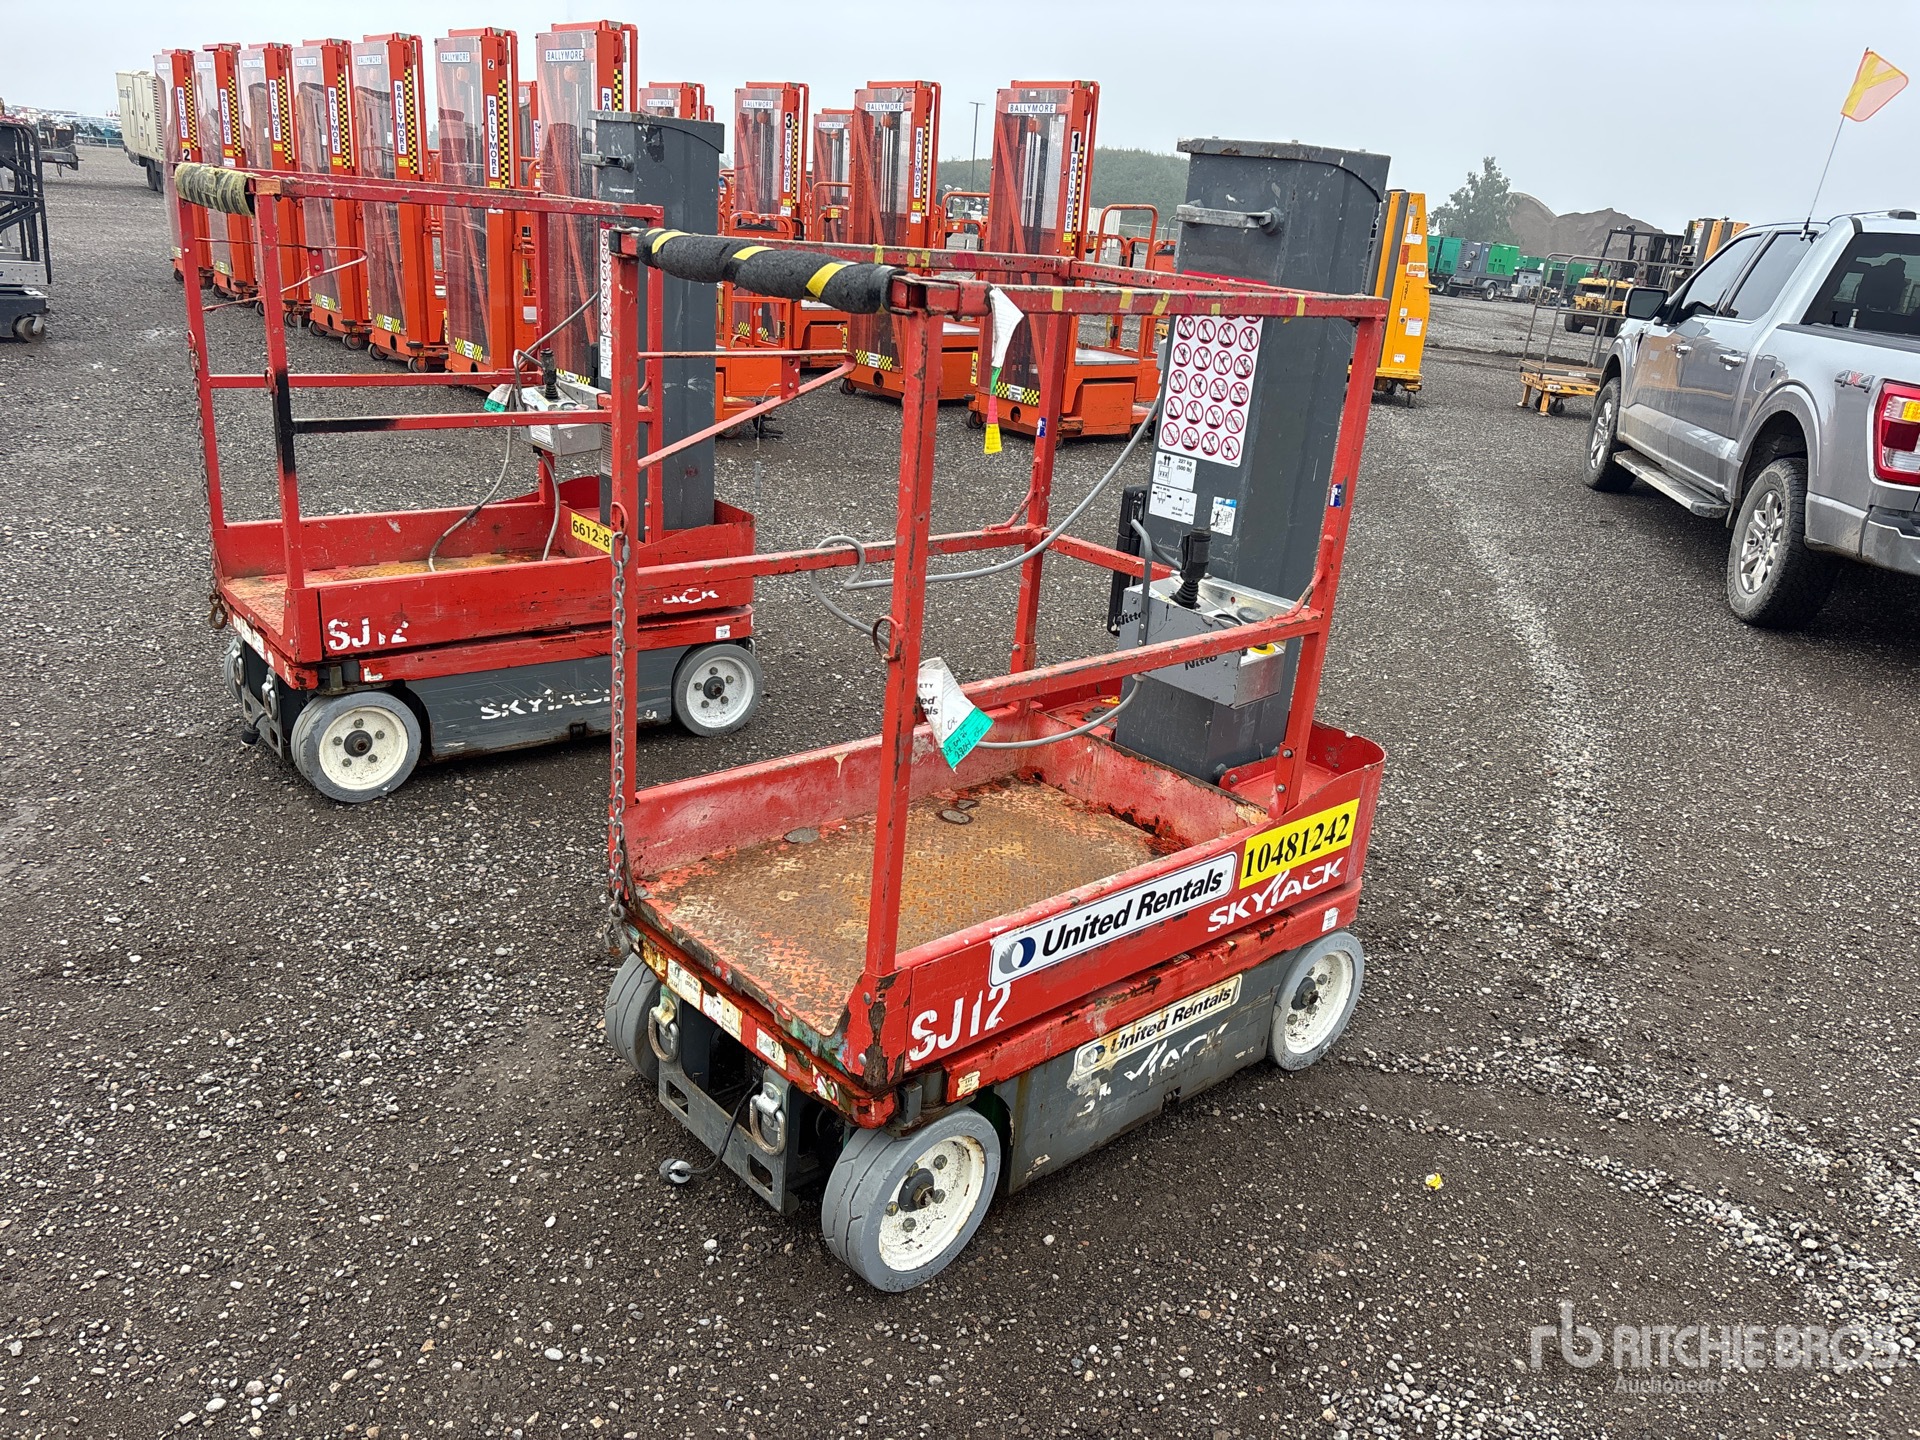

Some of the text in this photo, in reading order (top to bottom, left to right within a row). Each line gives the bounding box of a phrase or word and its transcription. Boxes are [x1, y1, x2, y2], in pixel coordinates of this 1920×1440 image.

[441, 53, 469, 62] BALLYMORE
[488, 59, 494, 70] 2
[547, 50, 583, 61] BALLYMORE
[178, 89, 187, 137] BALLYMORE
[221, 91, 230, 143] BALLYMORE
[270, 81, 280, 140] BALLYMORE
[330, 90, 339, 152] BALLYMORE
[396, 84, 405, 152] BALLYMORE
[603, 92, 611, 111] BA
[785, 112, 792, 129] 3
[867, 103, 902, 111] BALLYMORE
[1009, 103, 1054, 113] BALLYMORE
[183, 148, 191, 161] 2
[489, 99, 498, 175] BALLYMORE
[1073, 132, 1080, 152] 1
[914, 131, 922, 196] BALLYMORE
[1065, 156, 1076, 230] BALLYMORE
[572, 519, 613, 549] 6612-8
[1184, 655, 1218, 671] Nitto
[1242, 812, 1350, 880] 10481242
[1042, 868, 1223, 957] United Rentals
[1206, 856, 1345, 933] SKYJACK
[908, 981, 1014, 1062] SJ12
[1110, 987, 1232, 1054] United Rentals
